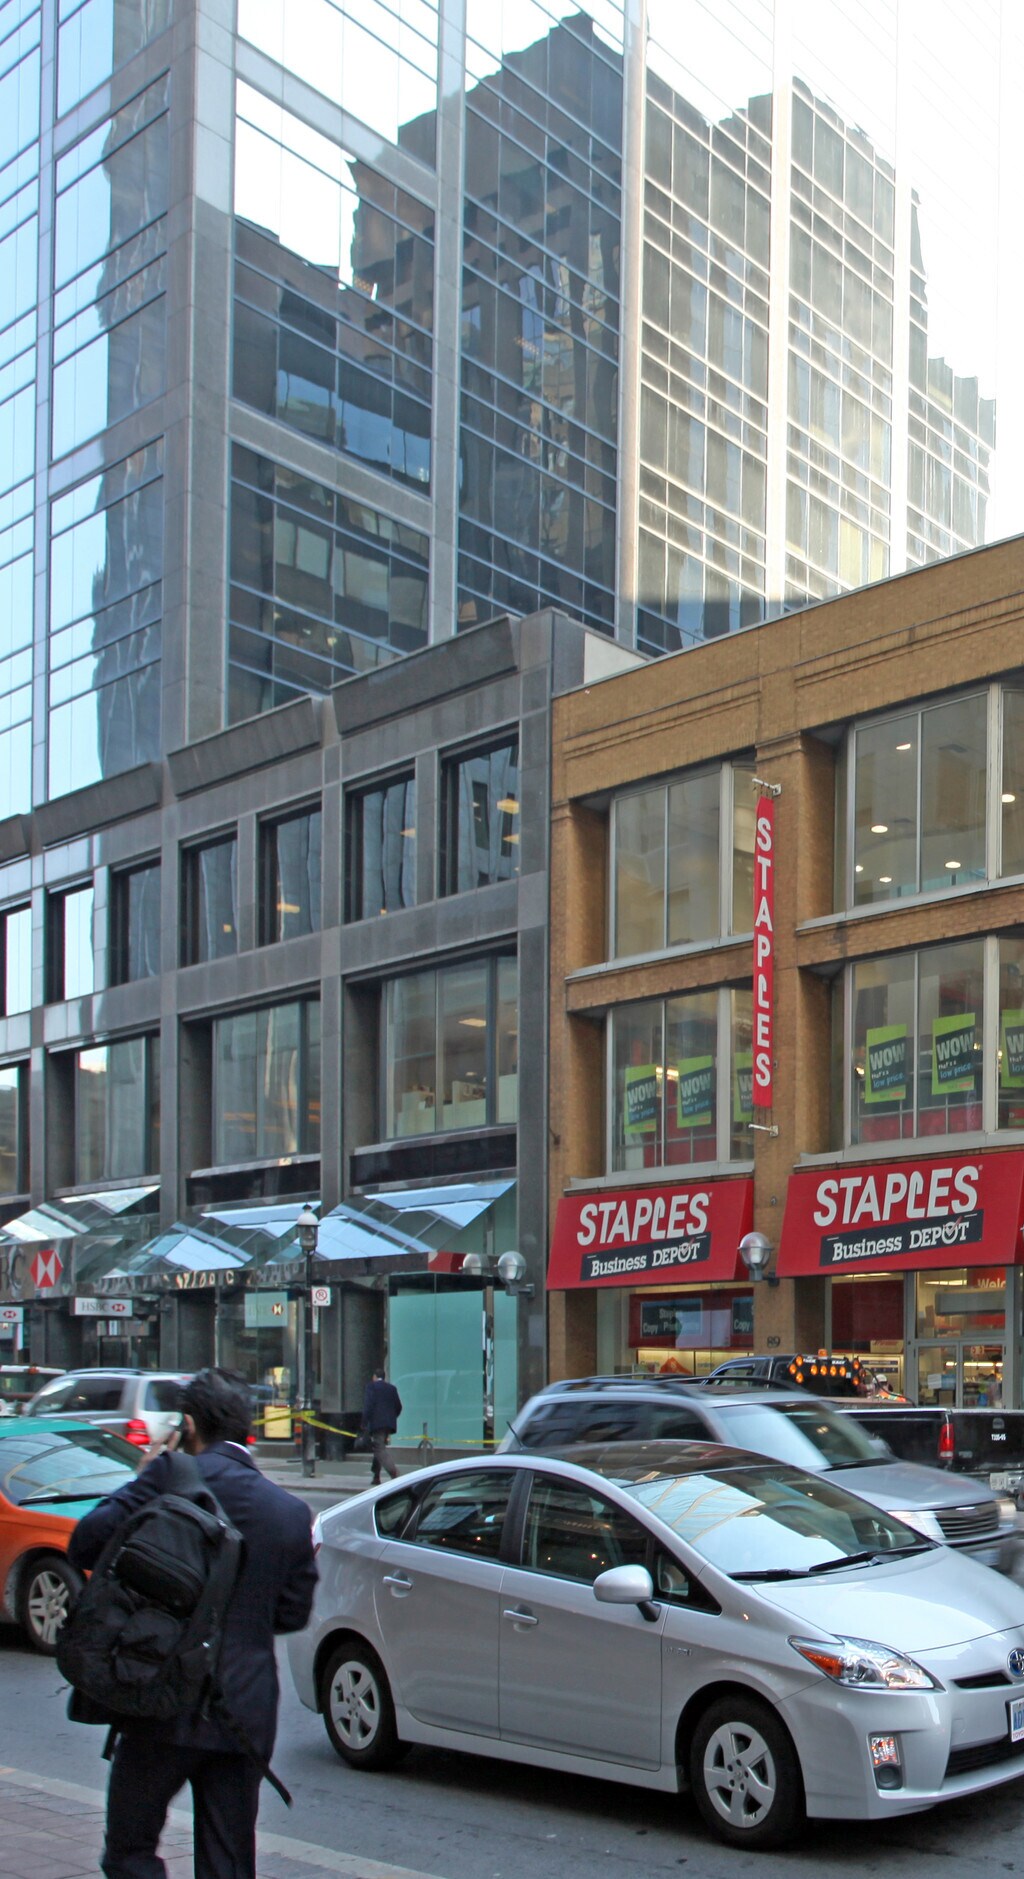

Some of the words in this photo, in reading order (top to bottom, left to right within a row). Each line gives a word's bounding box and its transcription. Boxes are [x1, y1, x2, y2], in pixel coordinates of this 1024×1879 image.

[755, 817, 773, 1087] STAPLES
[870, 1043, 905, 1071] WOW
[936, 1032, 974, 1061] WOW
[680, 1072, 711, 1098] WOW
[940, 1069, 953, 1079] low
[627, 1081, 656, 1104] WOW
[813, 1165, 979, 1227] STAPLES
[577, 1192, 709, 1246] STAPLES
[832, 1236, 903, 1262] Business
[909, 1221, 970, 1249] DEPOT
[590, 1255, 647, 1277] Business
[652, 1242, 700, 1267] DEPOT
[642, 1323, 659, 1335] Copy
[734, 1320, 750, 1332] Copy
[767, 1336, 781, 1348] 89
